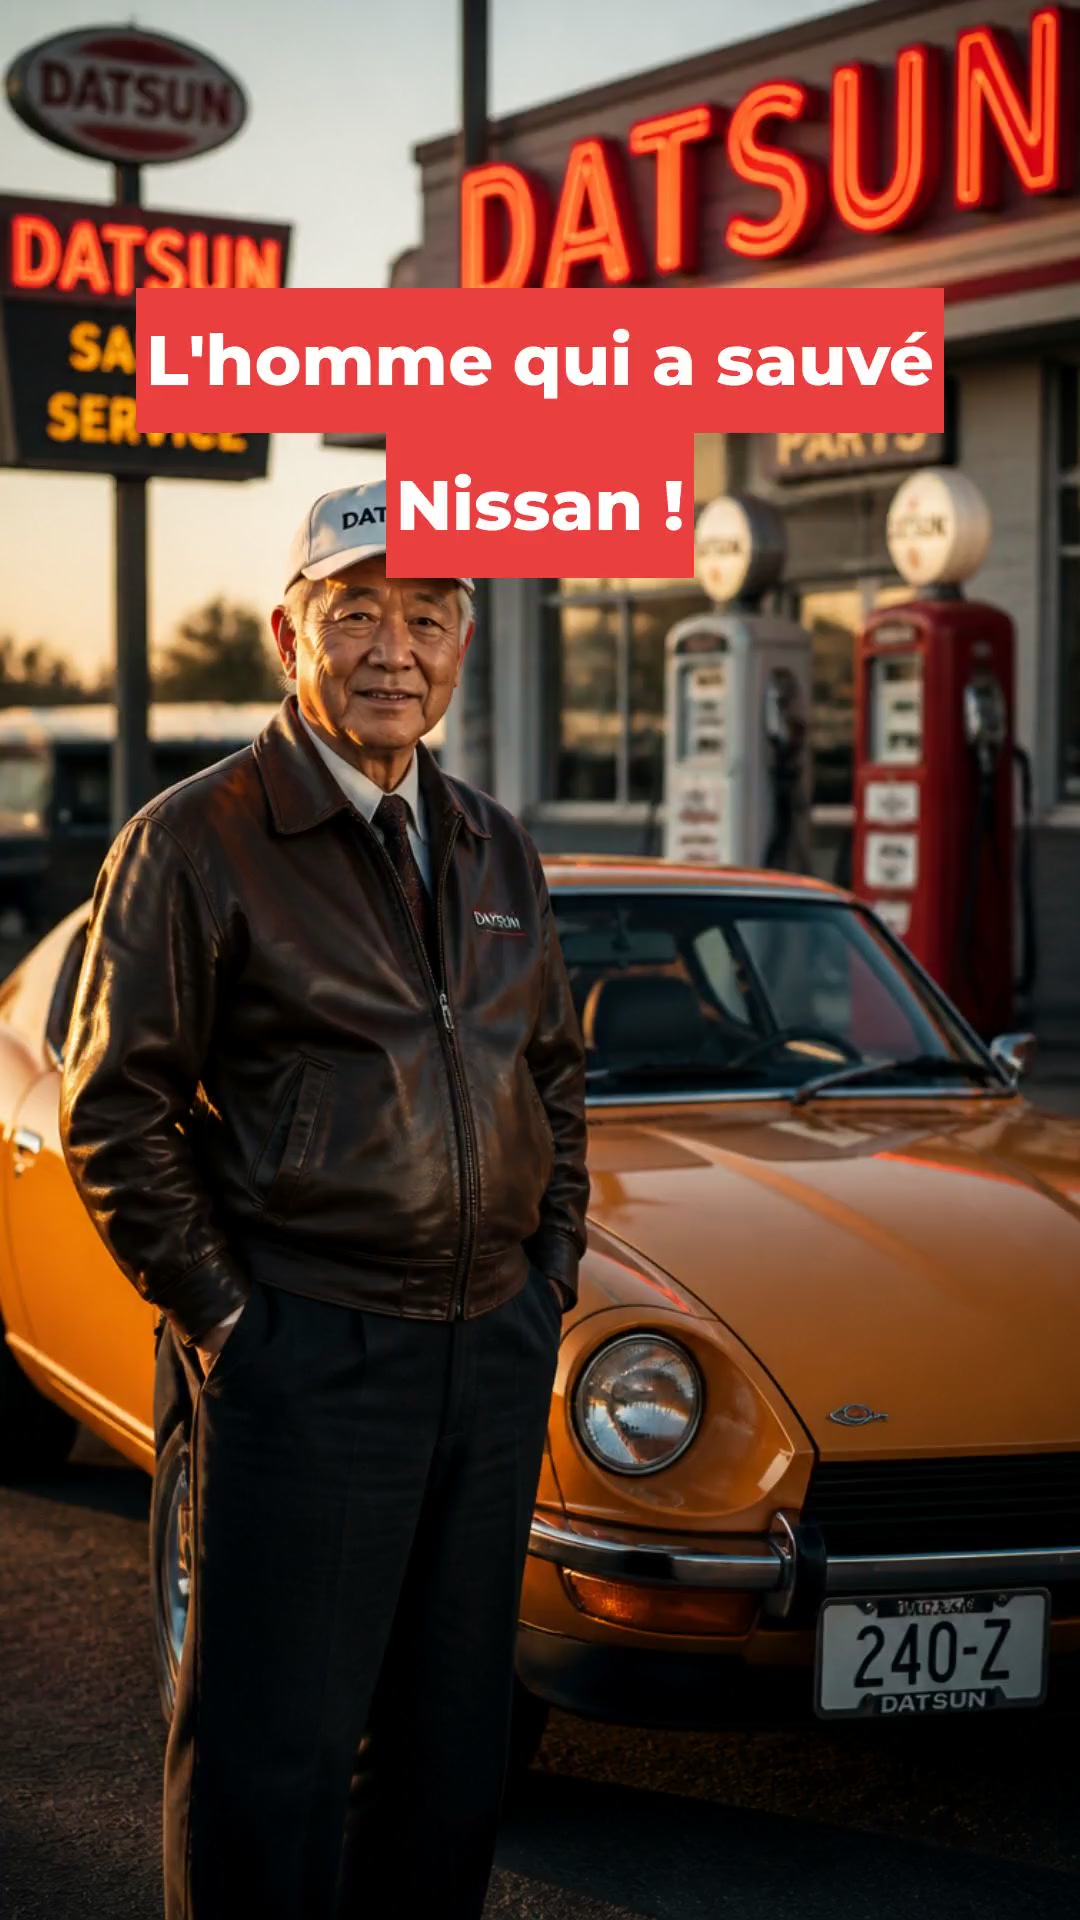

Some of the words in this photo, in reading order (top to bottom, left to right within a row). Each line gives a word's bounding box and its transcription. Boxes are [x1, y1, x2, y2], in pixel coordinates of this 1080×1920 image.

[40, 61, 232, 129] DATSUN
[462, 8, 1061, 288] DATSUN
[11, 214, 283, 296] DATSUN
[342, 507, 386, 530] DAT
[854, 1619, 1011, 1688] 240-Z
[881, 1691, 986, 1714] DATSUN
